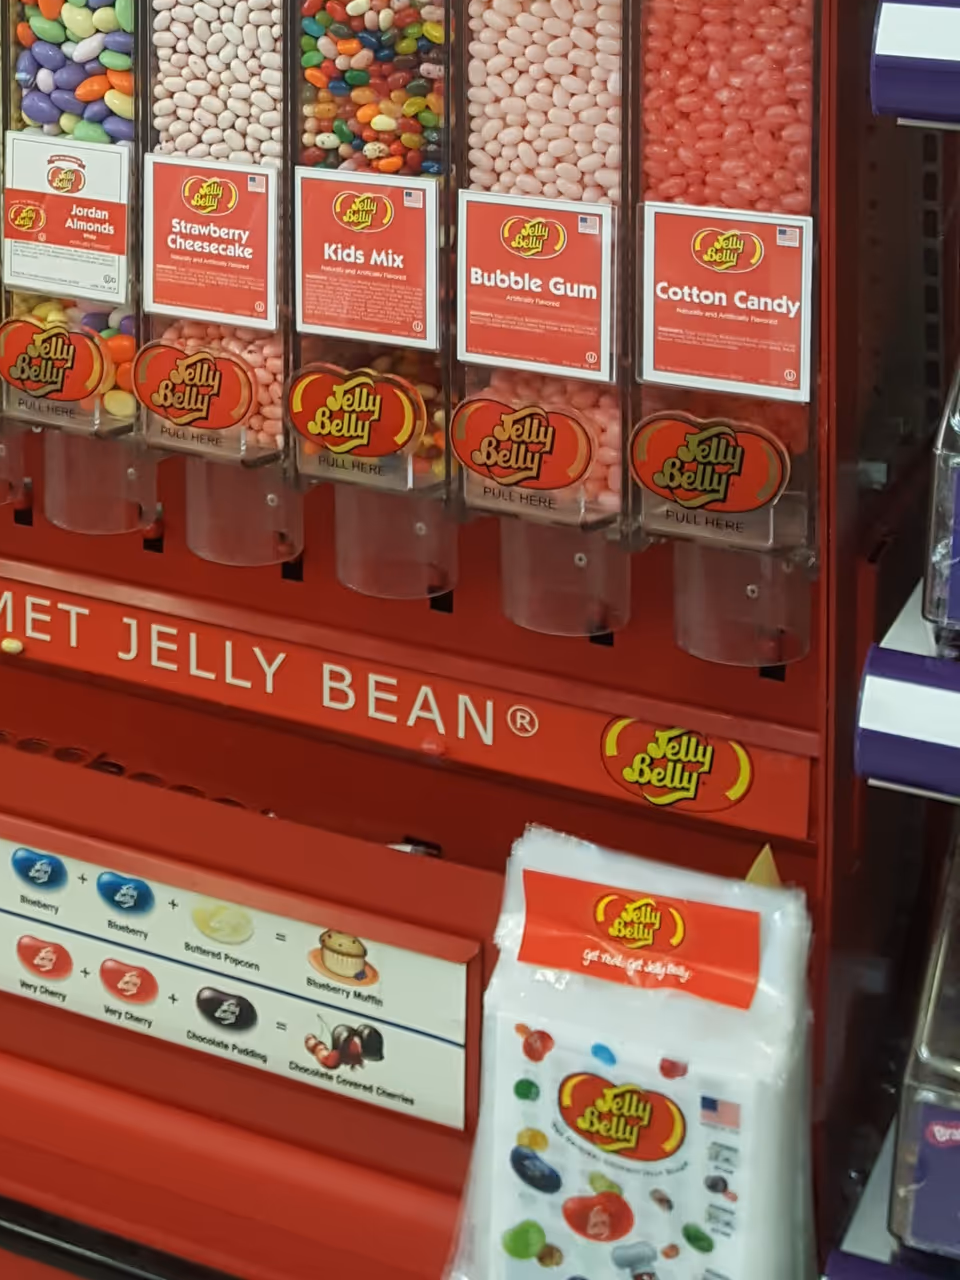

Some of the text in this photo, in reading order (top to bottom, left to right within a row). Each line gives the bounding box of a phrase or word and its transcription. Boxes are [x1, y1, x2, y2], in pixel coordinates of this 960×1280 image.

[65, 218, 115, 235] Almonds
[70, 204, 109, 220] Jordan
[167, 234, 254, 260] Cheesecake
[171, 218, 251, 245] Strawberry
[323, 242, 405, 270] Kids Mix
[470, 267, 598, 300] Bubble Gum
[655, 281, 801, 318] Cotton Candy
[27, 326, 75, 368] Jelly
[10, 355, 66, 397] Belly
[168, 352, 222, 395] Jelly
[18, 397, 76, 419] PULL HERE
[151, 383, 210, 427] Belly
[326, 376, 382, 421] Jelly
[191, 434, 223, 448] HERE
[307, 408, 371, 454] Belly
[494, 405, 556, 453] Jelly
[318, 455, 386, 477] PULL HERE
[472, 437, 540, 488] Belly
[678, 425, 745, 475] Jelly
[483, 486, 557, 510] PULL HERE
[653, 457, 728, 508] Belly
[665, 509, 744, 534] PULL HERE
[117, 616, 287, 695] JELLY
[647, 726, 713, 773] Jelly
[623, 755, 700, 806] Belly
[20, 894, 59, 915] Blueberry
[107, 919, 149, 941] Blueberry
[184, 941, 260, 972] Buttered Popcorn
[19, 979, 67, 1002] Very Cherry
[306, 976, 383, 1008] Blueberry Muffin
[103, 1004, 153, 1029] Very Cherry
[186, 1029, 268, 1065] Chocolate Pudding
[289, 1060, 334, 1083] Chocolate
[336, 1073, 374, 1093] Covered
[595, 1083, 651, 1125] Jelly
[576, 1112, 640, 1153] Belly
